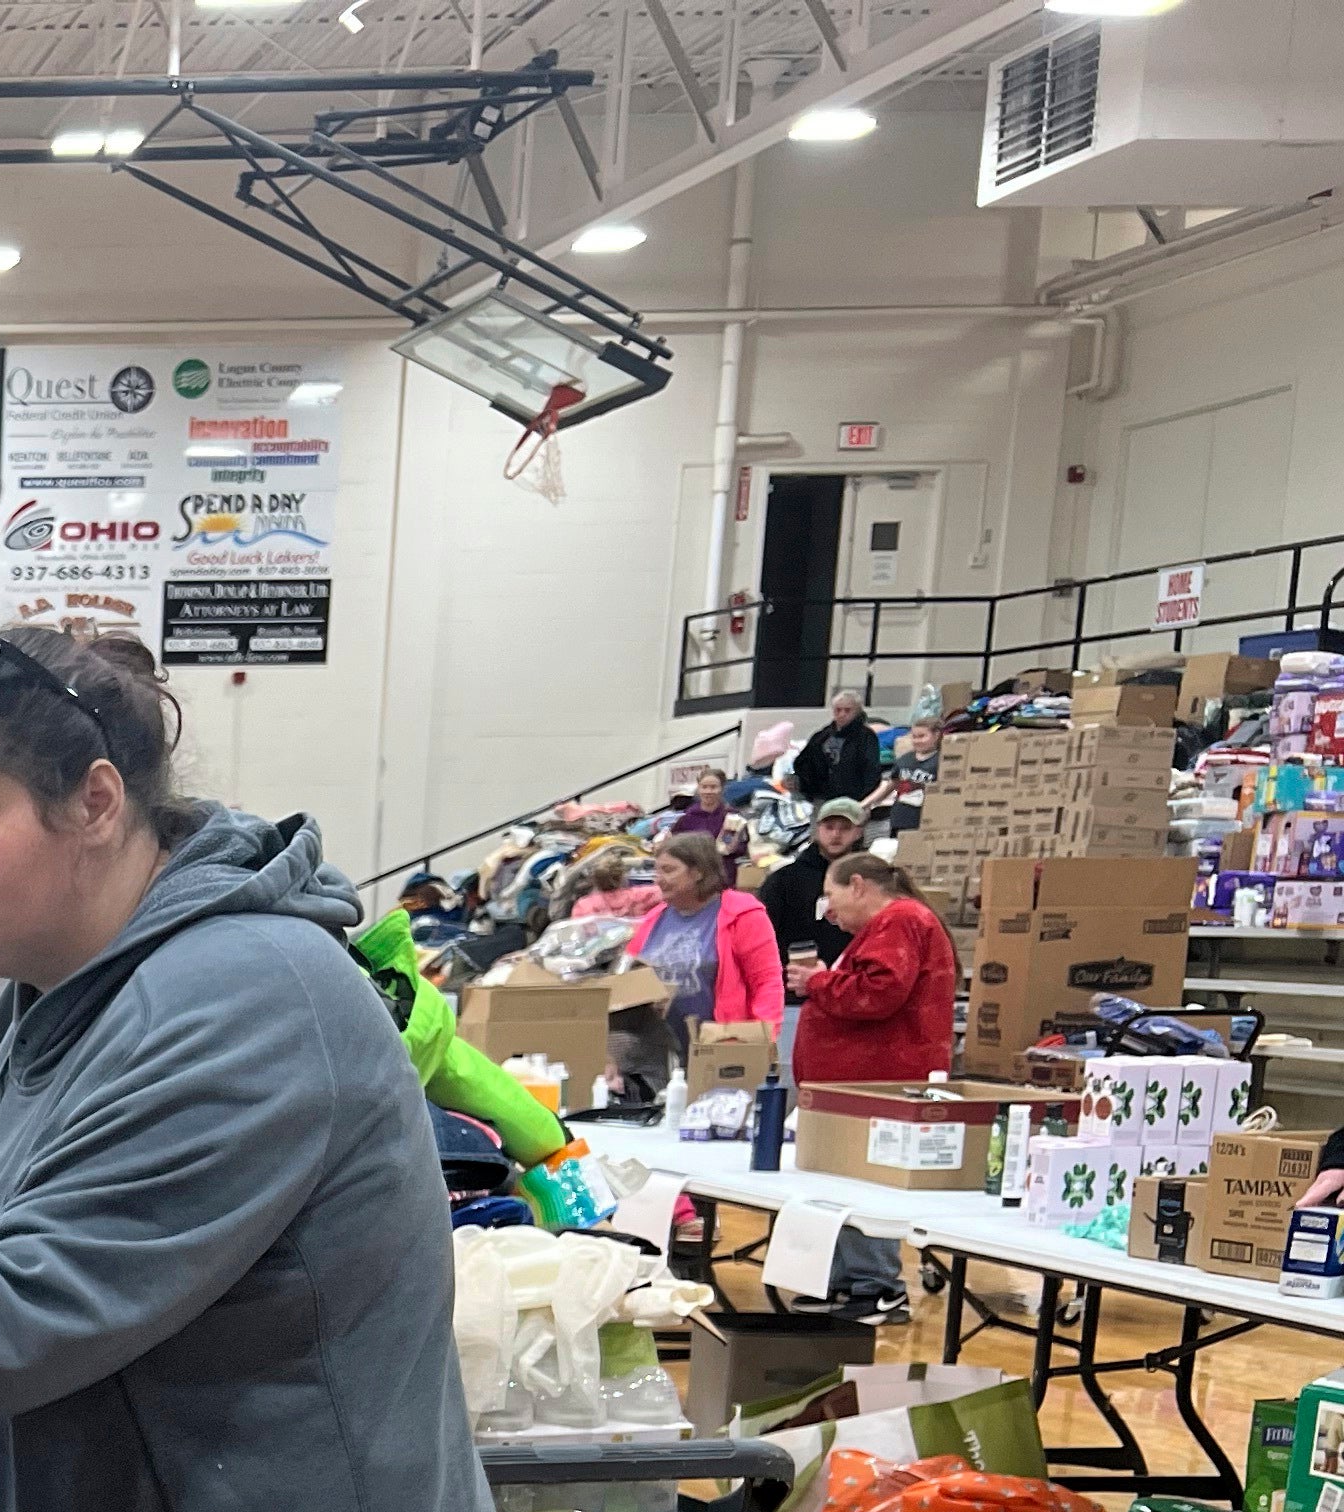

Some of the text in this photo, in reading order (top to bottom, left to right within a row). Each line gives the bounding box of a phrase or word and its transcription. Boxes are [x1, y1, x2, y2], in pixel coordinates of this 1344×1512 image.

[7, 367, 100, 406] Quest
[848, 425, 874, 445] EXIT
[170, 493, 307, 542] SPEND A DAY
[60, 521, 160, 541] OHIO
[187, 551, 321, 566] Good Luck Lakers!
[11, 566, 151, 580] 937-686-4313
[1167, 571, 1193, 597] HOME
[179, 602, 261, 618] ATTORNEYS
[280, 601, 316, 617] LAW
[1155, 597, 1200, 624] STUDENTS
[1224, 1177, 1294, 1198] TAMPAX
